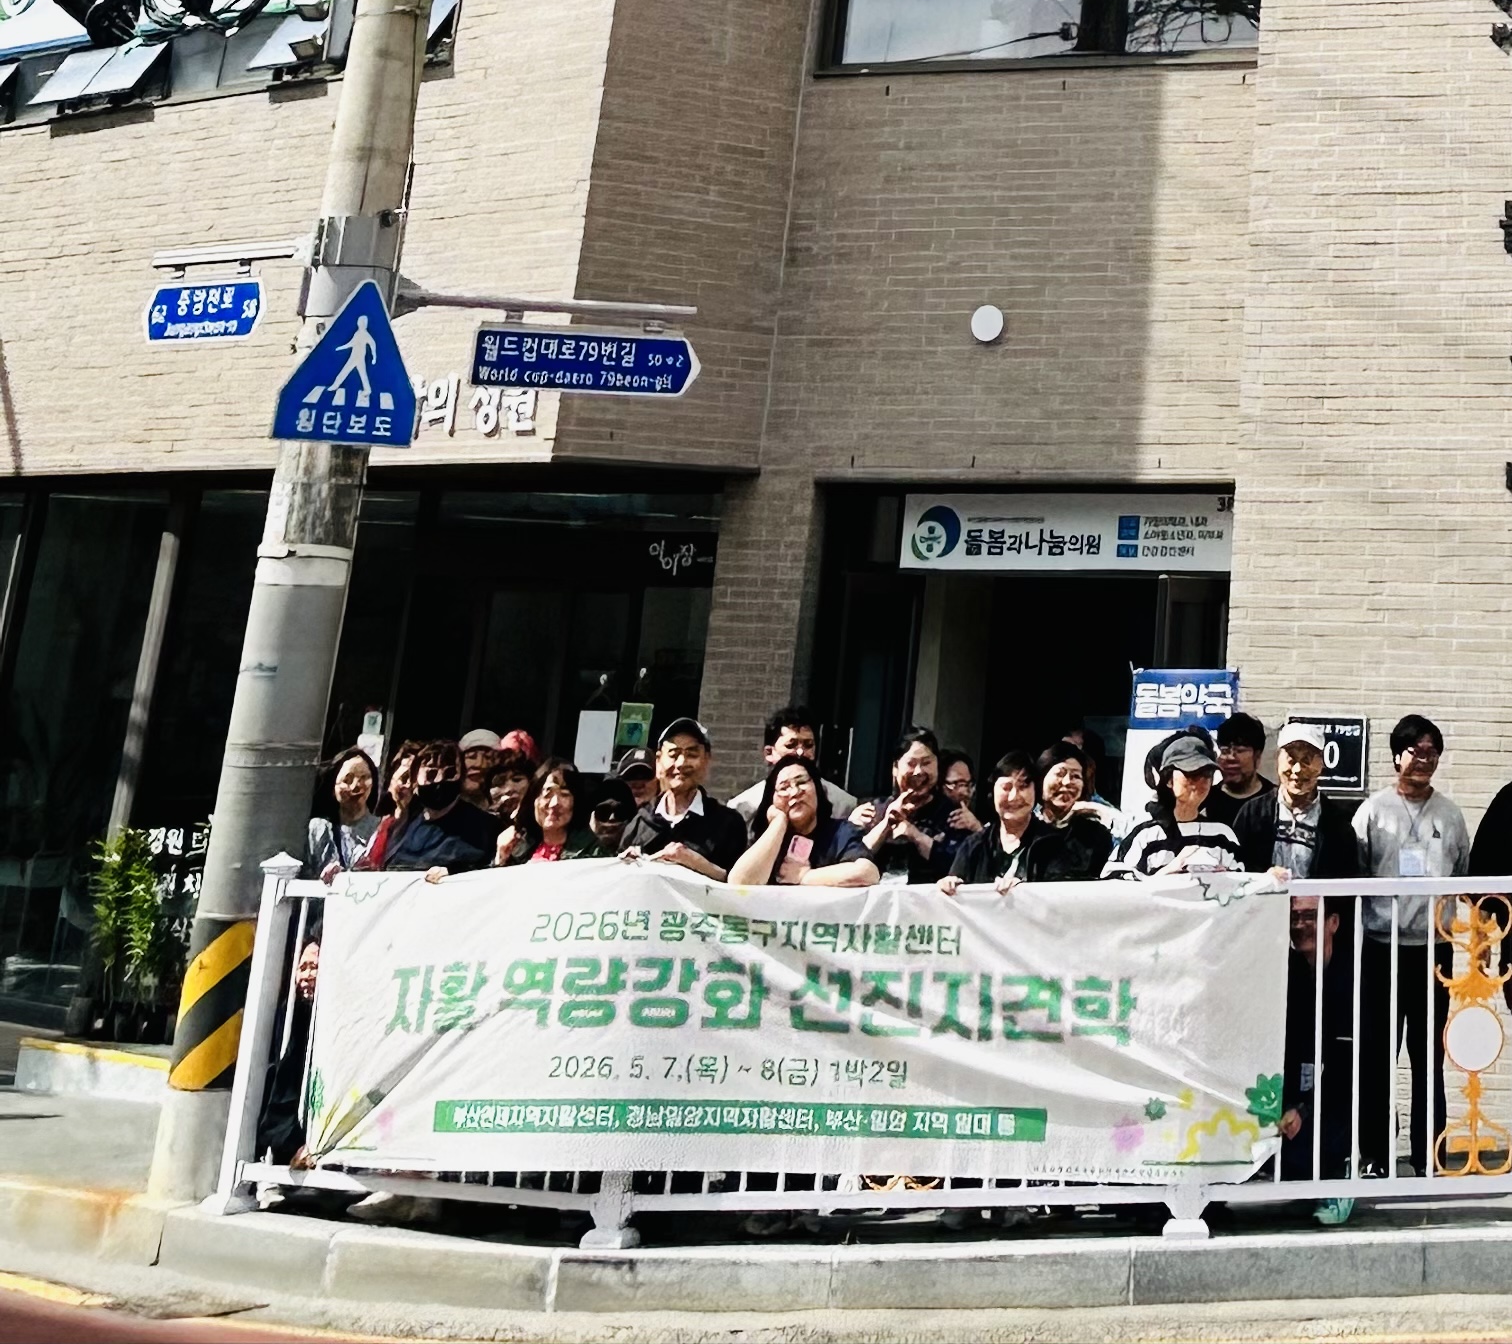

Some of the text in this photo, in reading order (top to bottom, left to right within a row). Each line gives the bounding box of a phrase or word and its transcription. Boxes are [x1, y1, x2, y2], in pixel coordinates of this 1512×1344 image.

[481, 334, 636, 367] 월드컵대로79번길
[478, 365, 518, 382] World
[295, 407, 392, 437] 횡단보도
[964, 528, 1102, 556] 돌봄과나눔의원
[1134, 679, 1235, 720] 돌봄약국
[530, 909, 963, 955] 2026년 광주동구지역자활센터
[385, 960, 488, 1036] 자활
[501, 956, 771, 1030] 역량강화
[760, 1057, 819, 1087] 8(금)
[829, 1059, 908, 1089] 1박2일
